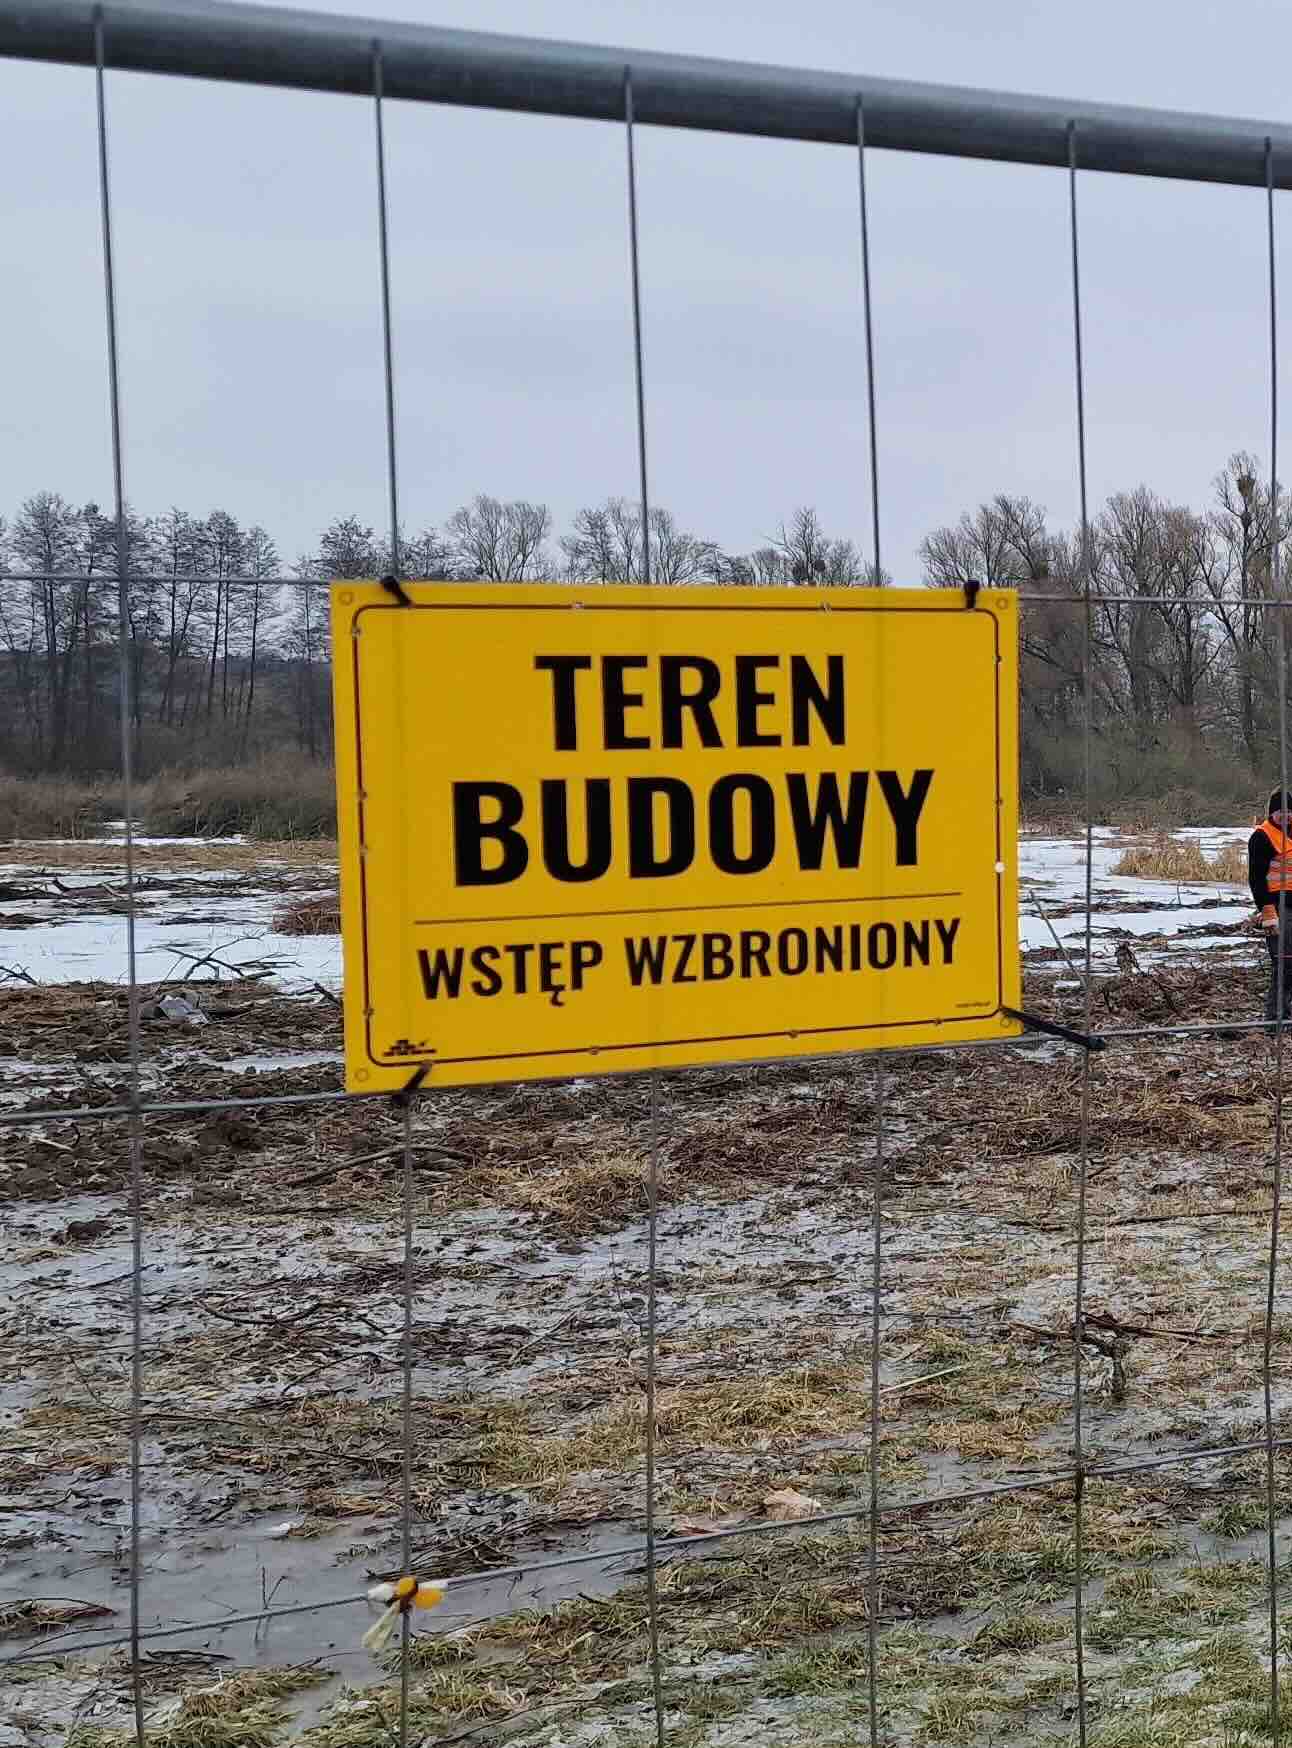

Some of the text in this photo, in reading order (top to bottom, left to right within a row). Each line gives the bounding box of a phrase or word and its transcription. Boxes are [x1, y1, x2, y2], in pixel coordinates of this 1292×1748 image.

[535, 655, 845, 751] TEREN
[453, 769, 935, 887] BUDOWY
[418, 918, 961, 1007] WSTĘP WZBRONIONY
